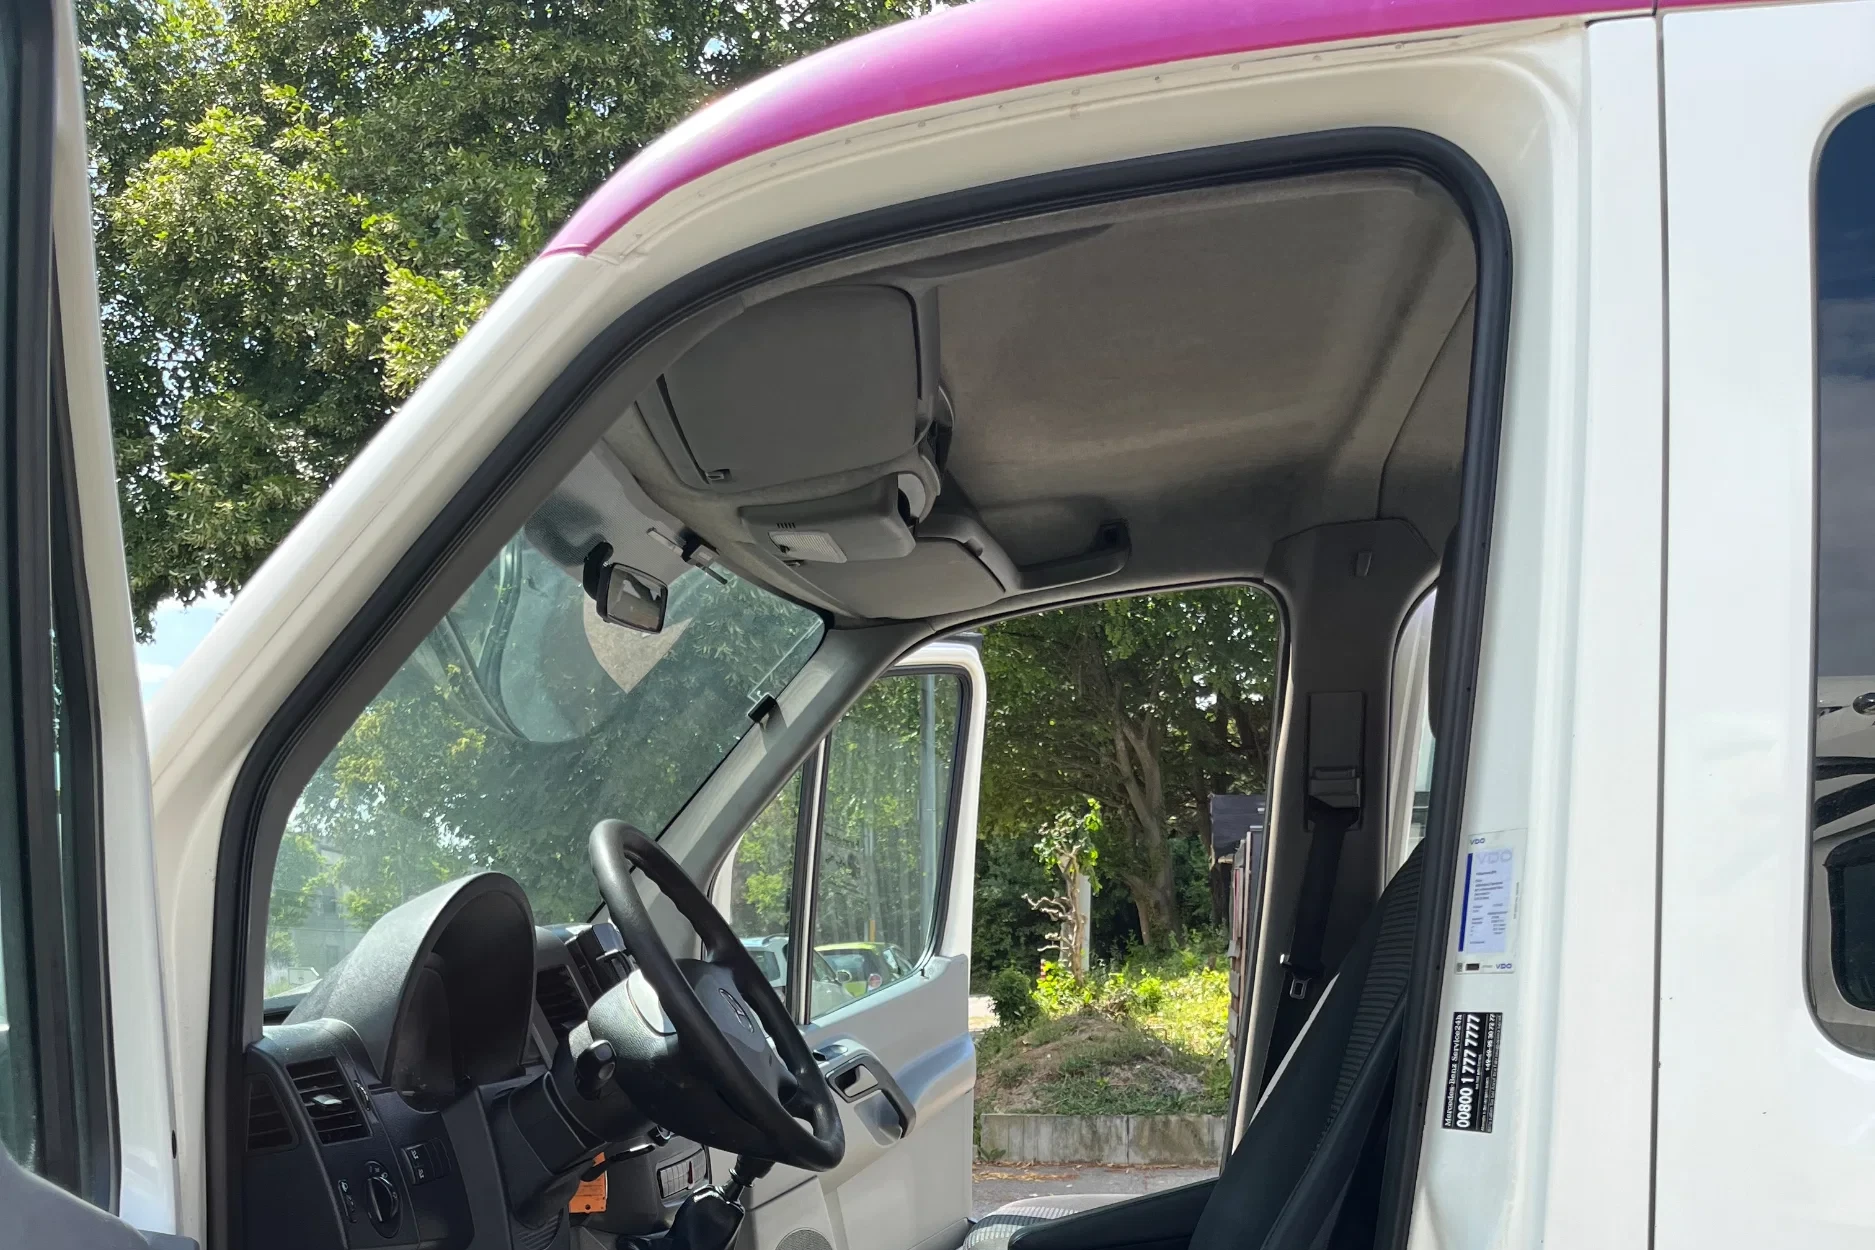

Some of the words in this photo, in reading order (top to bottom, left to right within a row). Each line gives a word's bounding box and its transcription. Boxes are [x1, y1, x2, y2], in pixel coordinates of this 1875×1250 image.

[1470, 837, 1485, 845] VDO
[1476, 849, 1513, 864] VDO
[1495, 962, 1513, 970] VDO
[1465, 1014, 1480, 1047] 7777
[1445, 1063, 1457, 1127] Mercedes-Benz
[1452, 1014, 1463, 1062] Service24h
[1462, 1049, 1477, 1074] 777
[1460, 1076, 1475, 1084] 1
[1457, 1087, 1473, 1128] 00800
